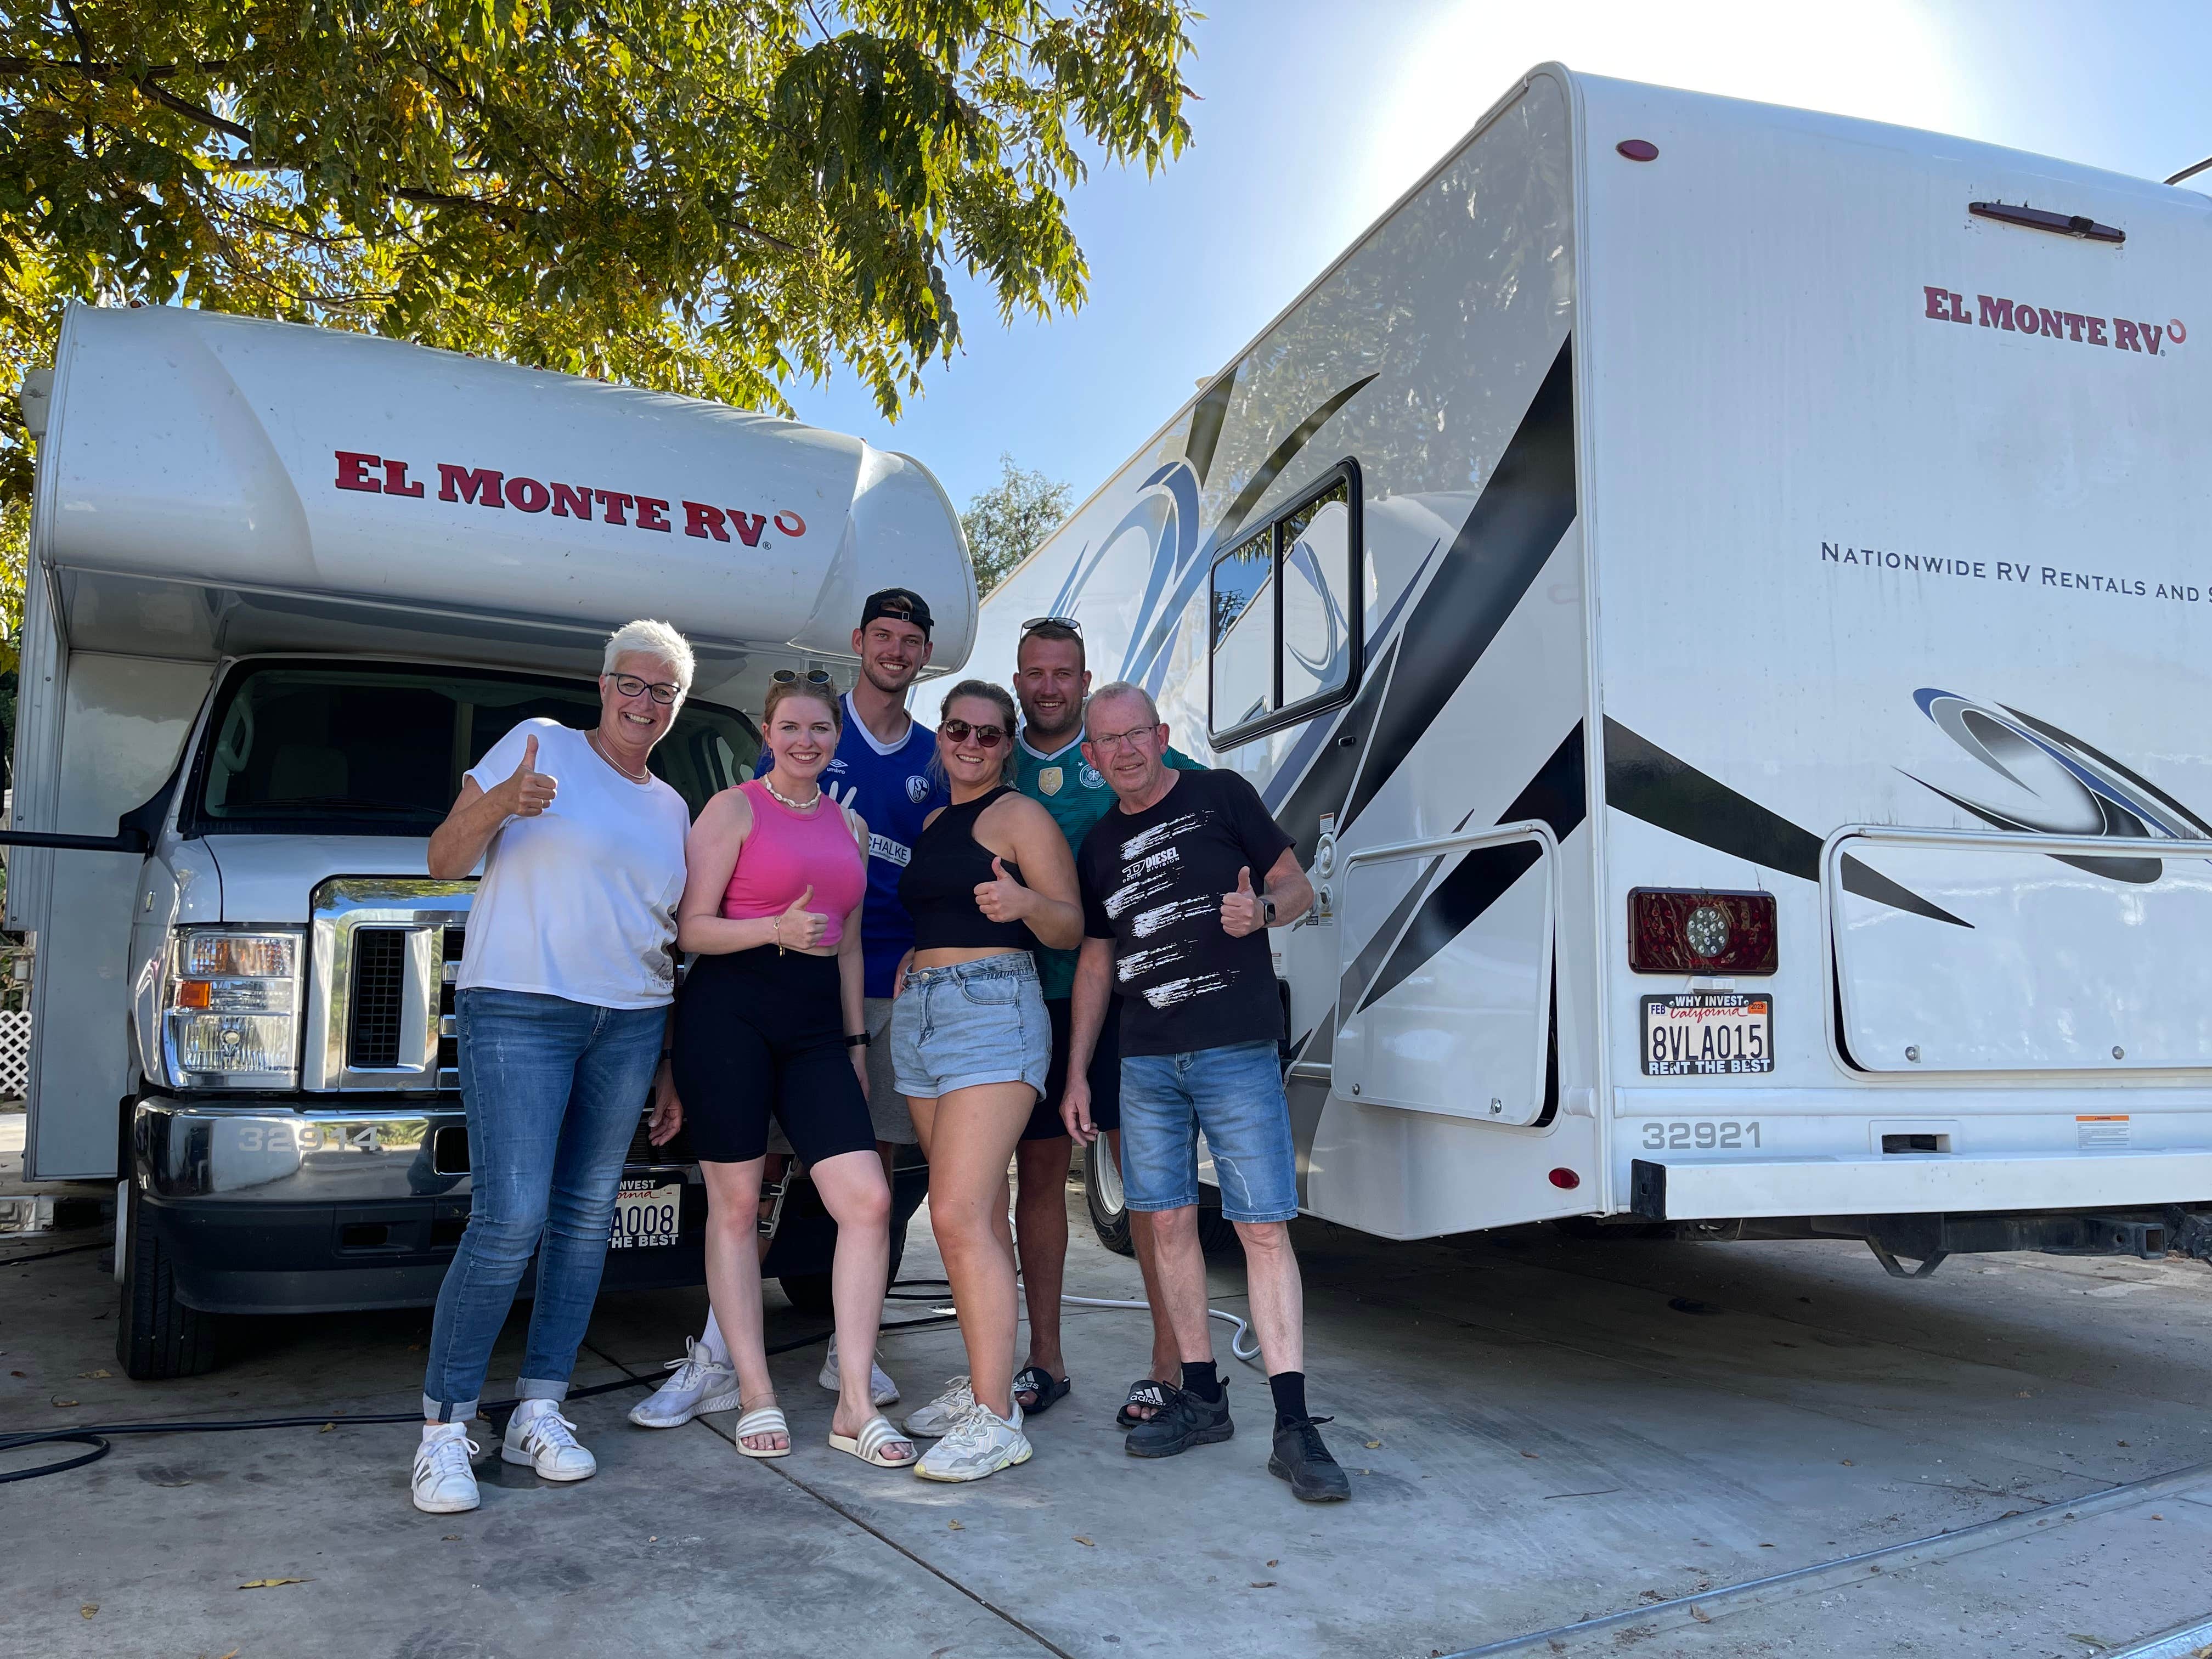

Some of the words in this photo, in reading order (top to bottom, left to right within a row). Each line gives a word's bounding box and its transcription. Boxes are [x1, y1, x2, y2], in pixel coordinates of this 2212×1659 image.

[1924, 286, 1972, 325] EL
[1977, 295, 2107, 347] MONTE
[2113, 318, 2162, 355] RV
[335, 450, 425, 498] EL
[437, 463, 671, 533] MONTE
[682, 500, 767, 548] RV
[1996, 562, 2030, 583] RV
[2155, 583, 2199, 602] AND
[868, 836, 907, 861] HALKE
[1146, 847, 1179, 868] DIESEL
[1147, 856, 1180, 872] DIVISION
[1675, 996, 1701, 1007] WHY
[1705, 995, 1744, 1007] INVEST
[1651, 1005, 1666, 1014] FEB
[1671, 1007, 1748, 1023] California
[1653, 1024, 1762, 1060] 8VLA015
[1649, 1061, 1690, 1075] RENT
[1695, 1060, 1726, 1074] THE
[1731, 1059, 1771, 1073] BEST
[238, 1126, 380, 1152] 32914
[1642, 1121, 1761, 1150] 32921
[616, 1190, 660, 1200] ornia
[619, 1180, 656, 1190] NVEST
[611, 1205, 674, 1237] A008
[607, 1236, 633, 1248] HE
[639, 1234, 679, 1246] BEST
